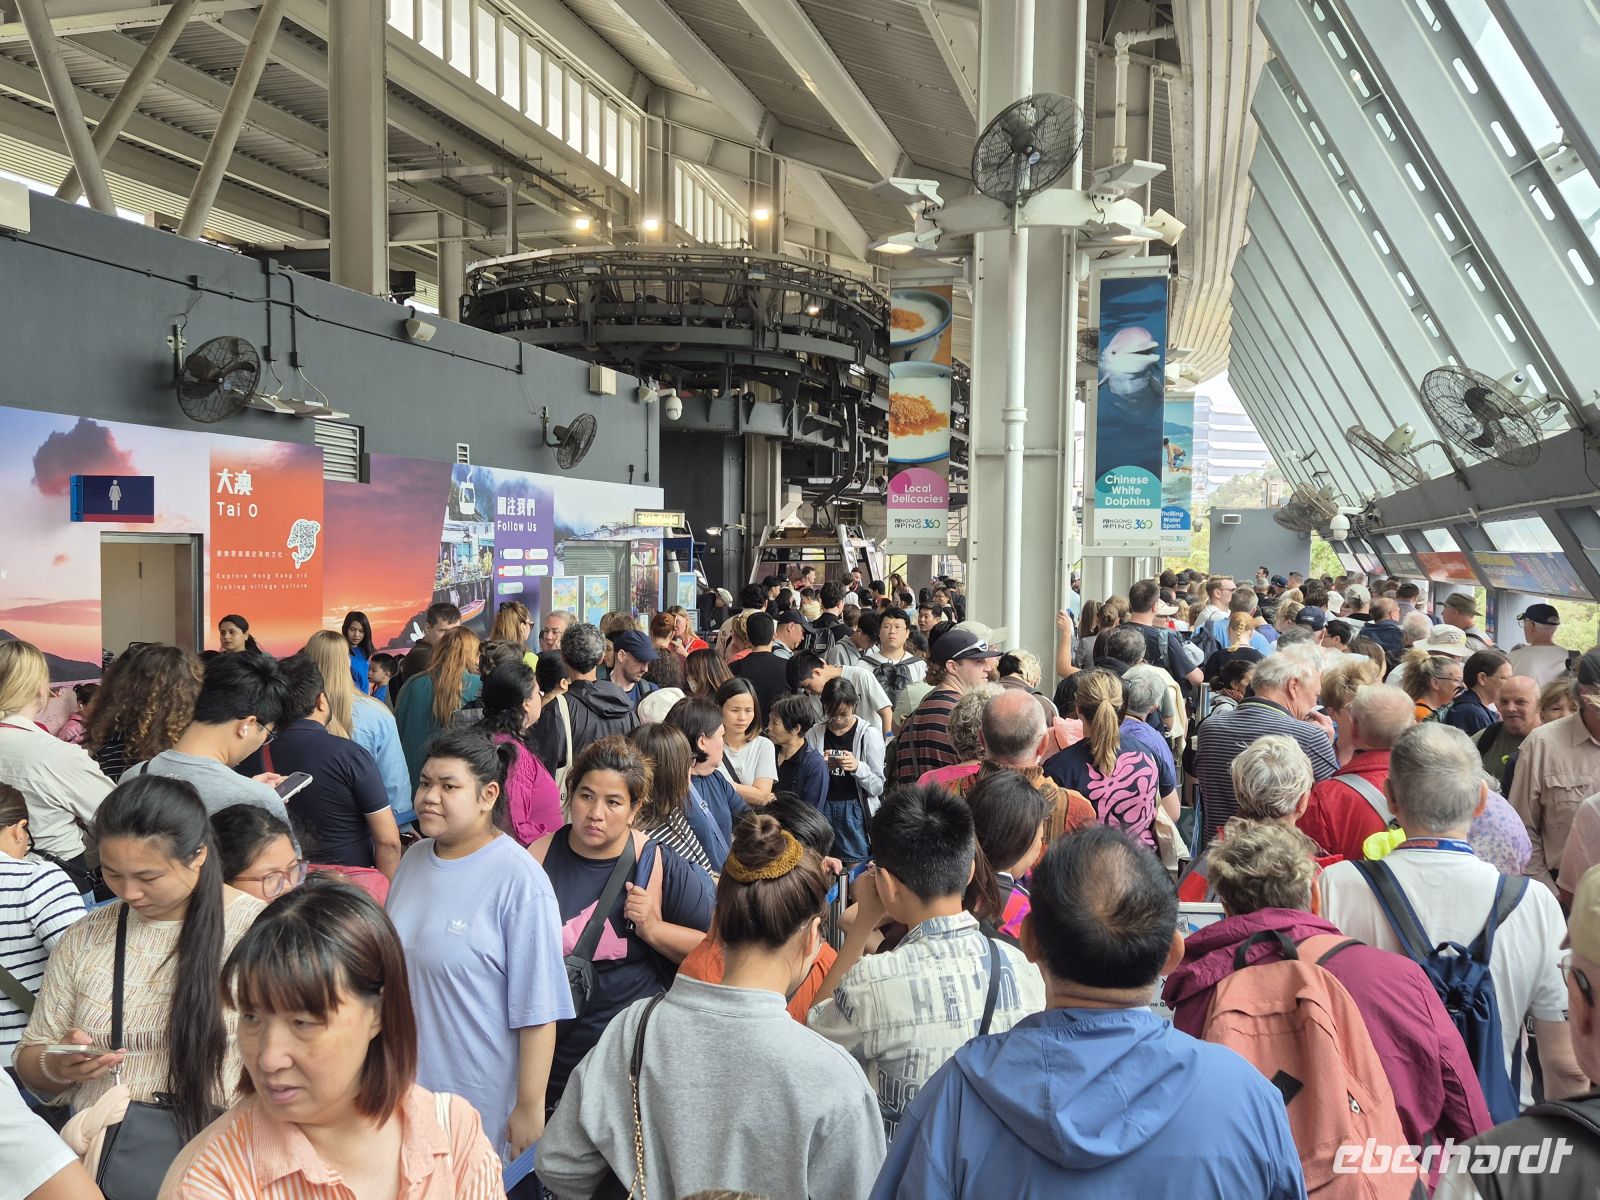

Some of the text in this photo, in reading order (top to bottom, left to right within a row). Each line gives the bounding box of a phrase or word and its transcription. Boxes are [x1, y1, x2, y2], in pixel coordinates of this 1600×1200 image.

[216, 468, 253, 496] 大澳
[1105, 475, 1149, 484] Chinese
[904, 484, 931, 493] Local
[1112, 486, 1142, 495] White
[892, 494, 944, 503] Delicacies
[1105, 497, 1151, 507] Dolphins
[217, 501, 241, 516] Tai
[497, 521, 537, 532] Follow Us
[923, 518, 941, 529] 360
[1133, 519, 1153, 529] 360
